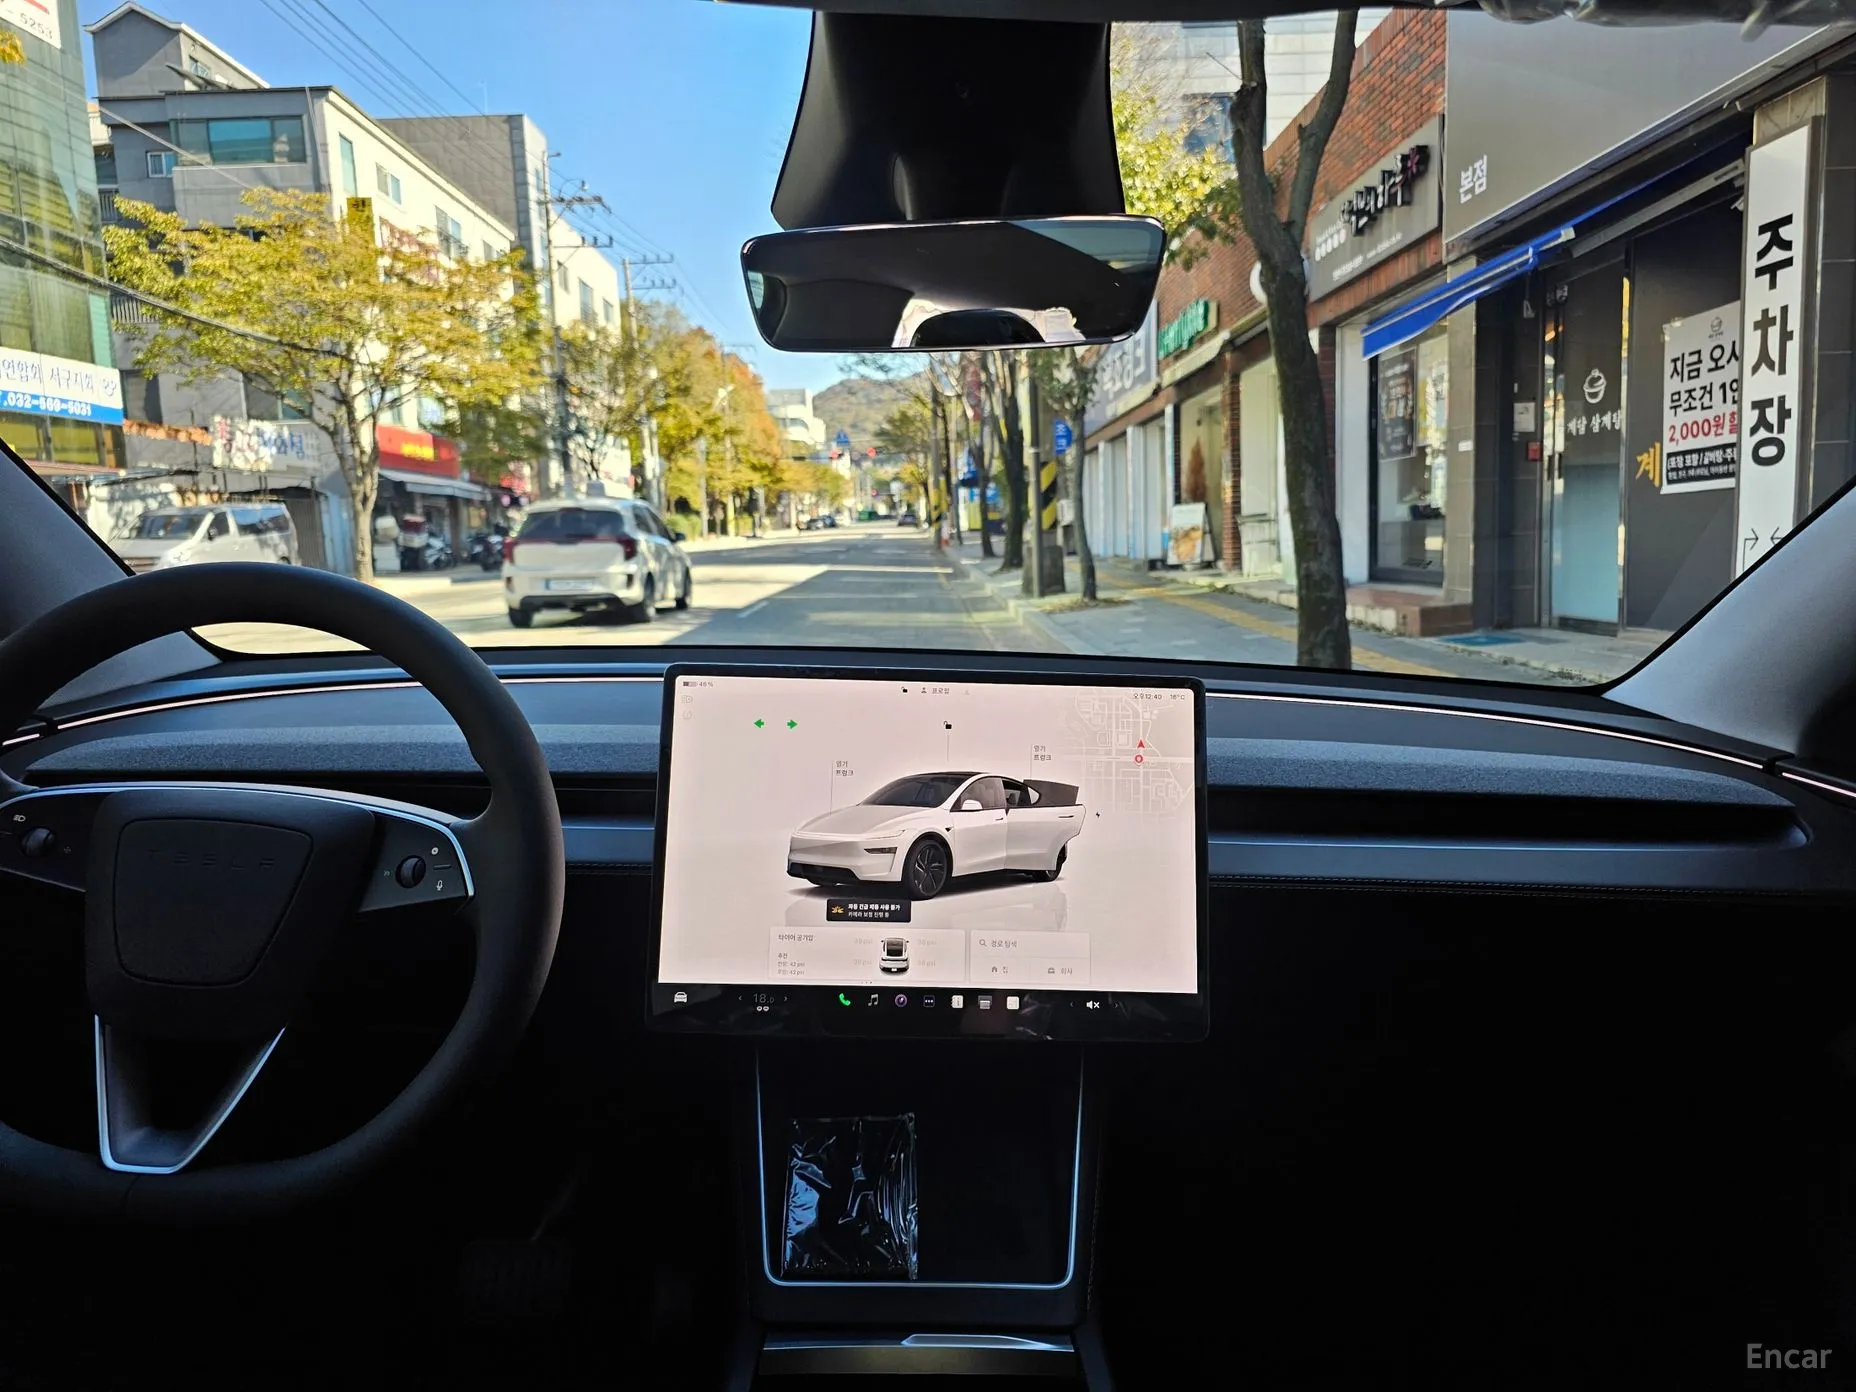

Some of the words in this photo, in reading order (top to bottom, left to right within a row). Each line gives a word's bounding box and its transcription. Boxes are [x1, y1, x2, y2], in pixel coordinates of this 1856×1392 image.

[1460, 155, 1487, 204] 본점
[1749, 213, 1795, 466] 주차장
[1669, 350, 1703, 383] 지금
[1669, 382, 1713, 417] 무조건
[1669, 413, 1725, 446] 2,000원
[1636, 442, 1661, 488] 계
